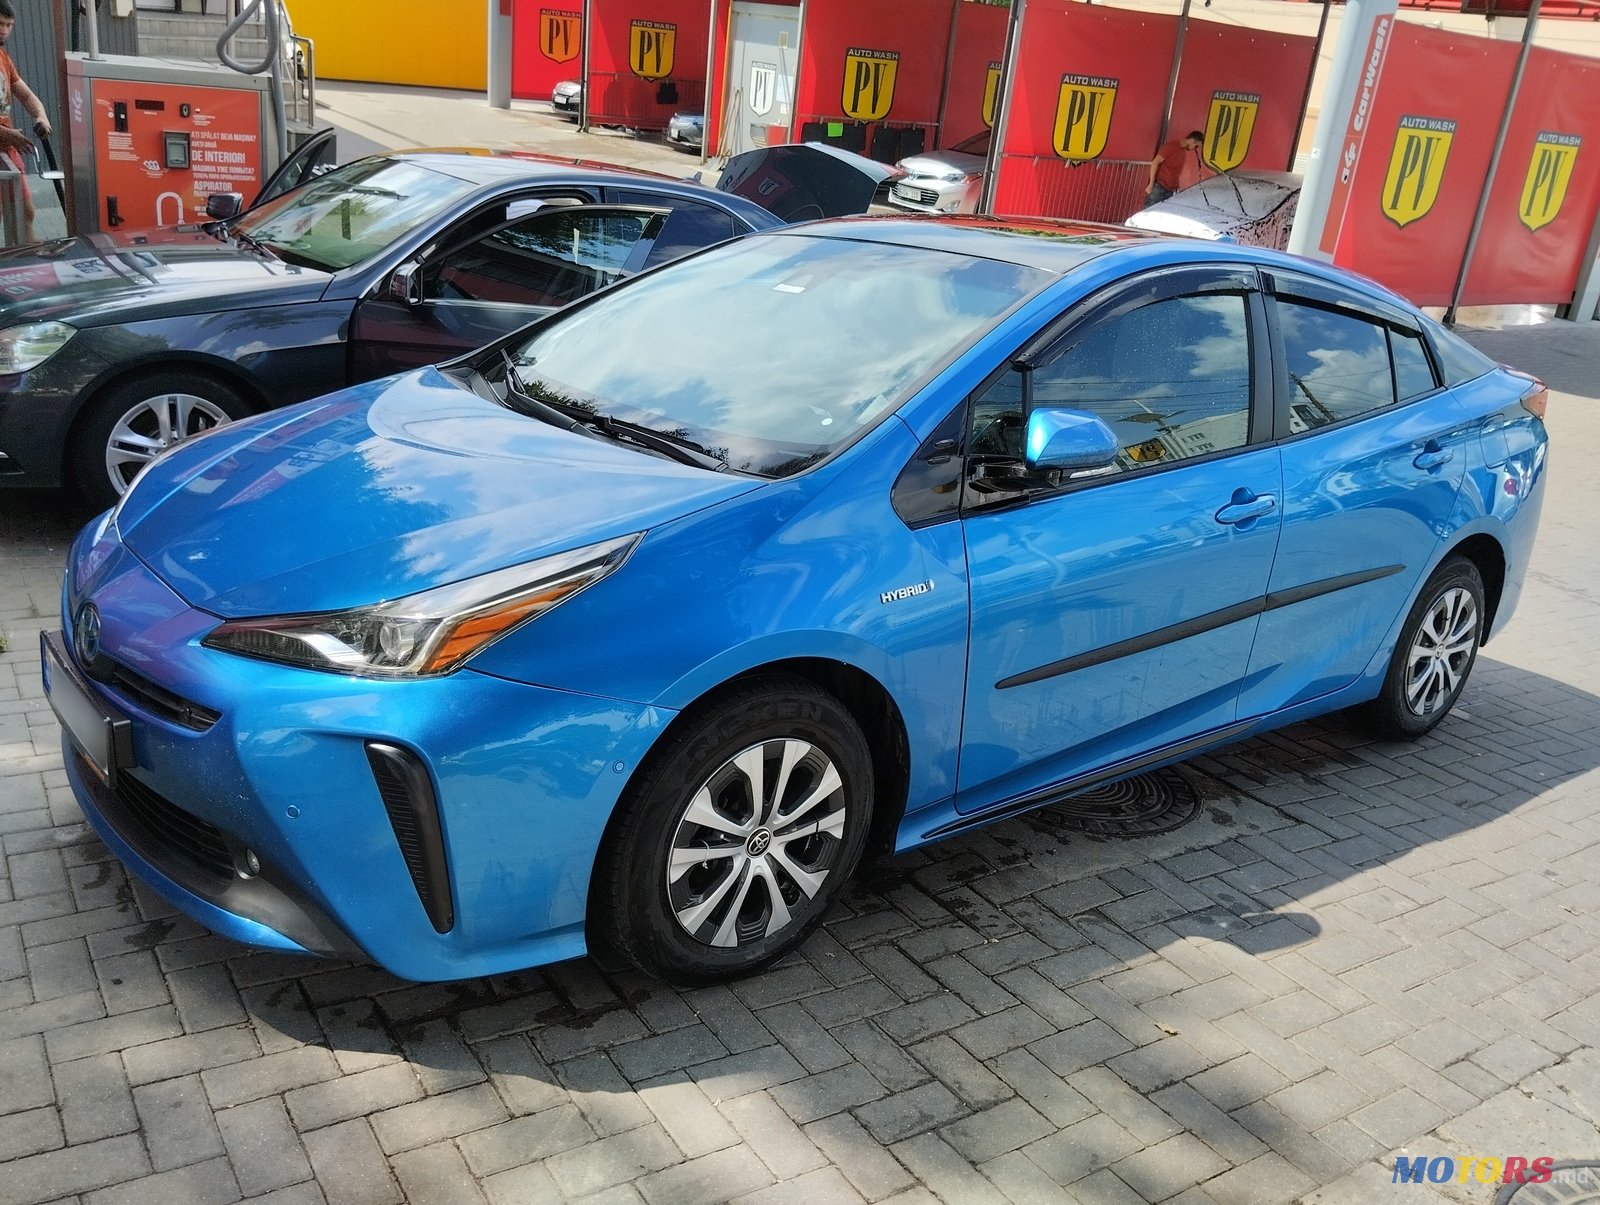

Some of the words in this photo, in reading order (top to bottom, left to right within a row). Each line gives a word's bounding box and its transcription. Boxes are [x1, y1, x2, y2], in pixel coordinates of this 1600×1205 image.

[632, 20, 653, 28] AUTO
[548, 18, 573, 55] PV
[638, 30, 667, 73] PV
[848, 48, 872, 57] AUTO
[874, 51, 899, 60] WASH
[753, 70, 773, 109] PV
[850, 60, 888, 114] PV
[1063, 75, 1089, 85] AUTO
[1090, 77, 1118, 88] WASH
[1214, 91, 1236, 100] AUTO
[1237, 94, 1260, 102] WASH
[1061, 90, 1105, 152] PV
[1401, 116, 1428, 129] AUTO
[1428, 119, 1456, 132] WASH
[1209, 104, 1248, 161] PV
[1537, 133, 1558, 144] AUTO
[1558, 135, 1580, 146] WASH
[192, 150, 203, 161] DE
[204, 150, 246, 164] INTERIOR!
[1388, 134, 1442, 211] PV
[1524, 148, 1568, 217] PV
[194, 180, 233, 191] ASPIRATOR
[880, 582, 928, 604] HYBRID
